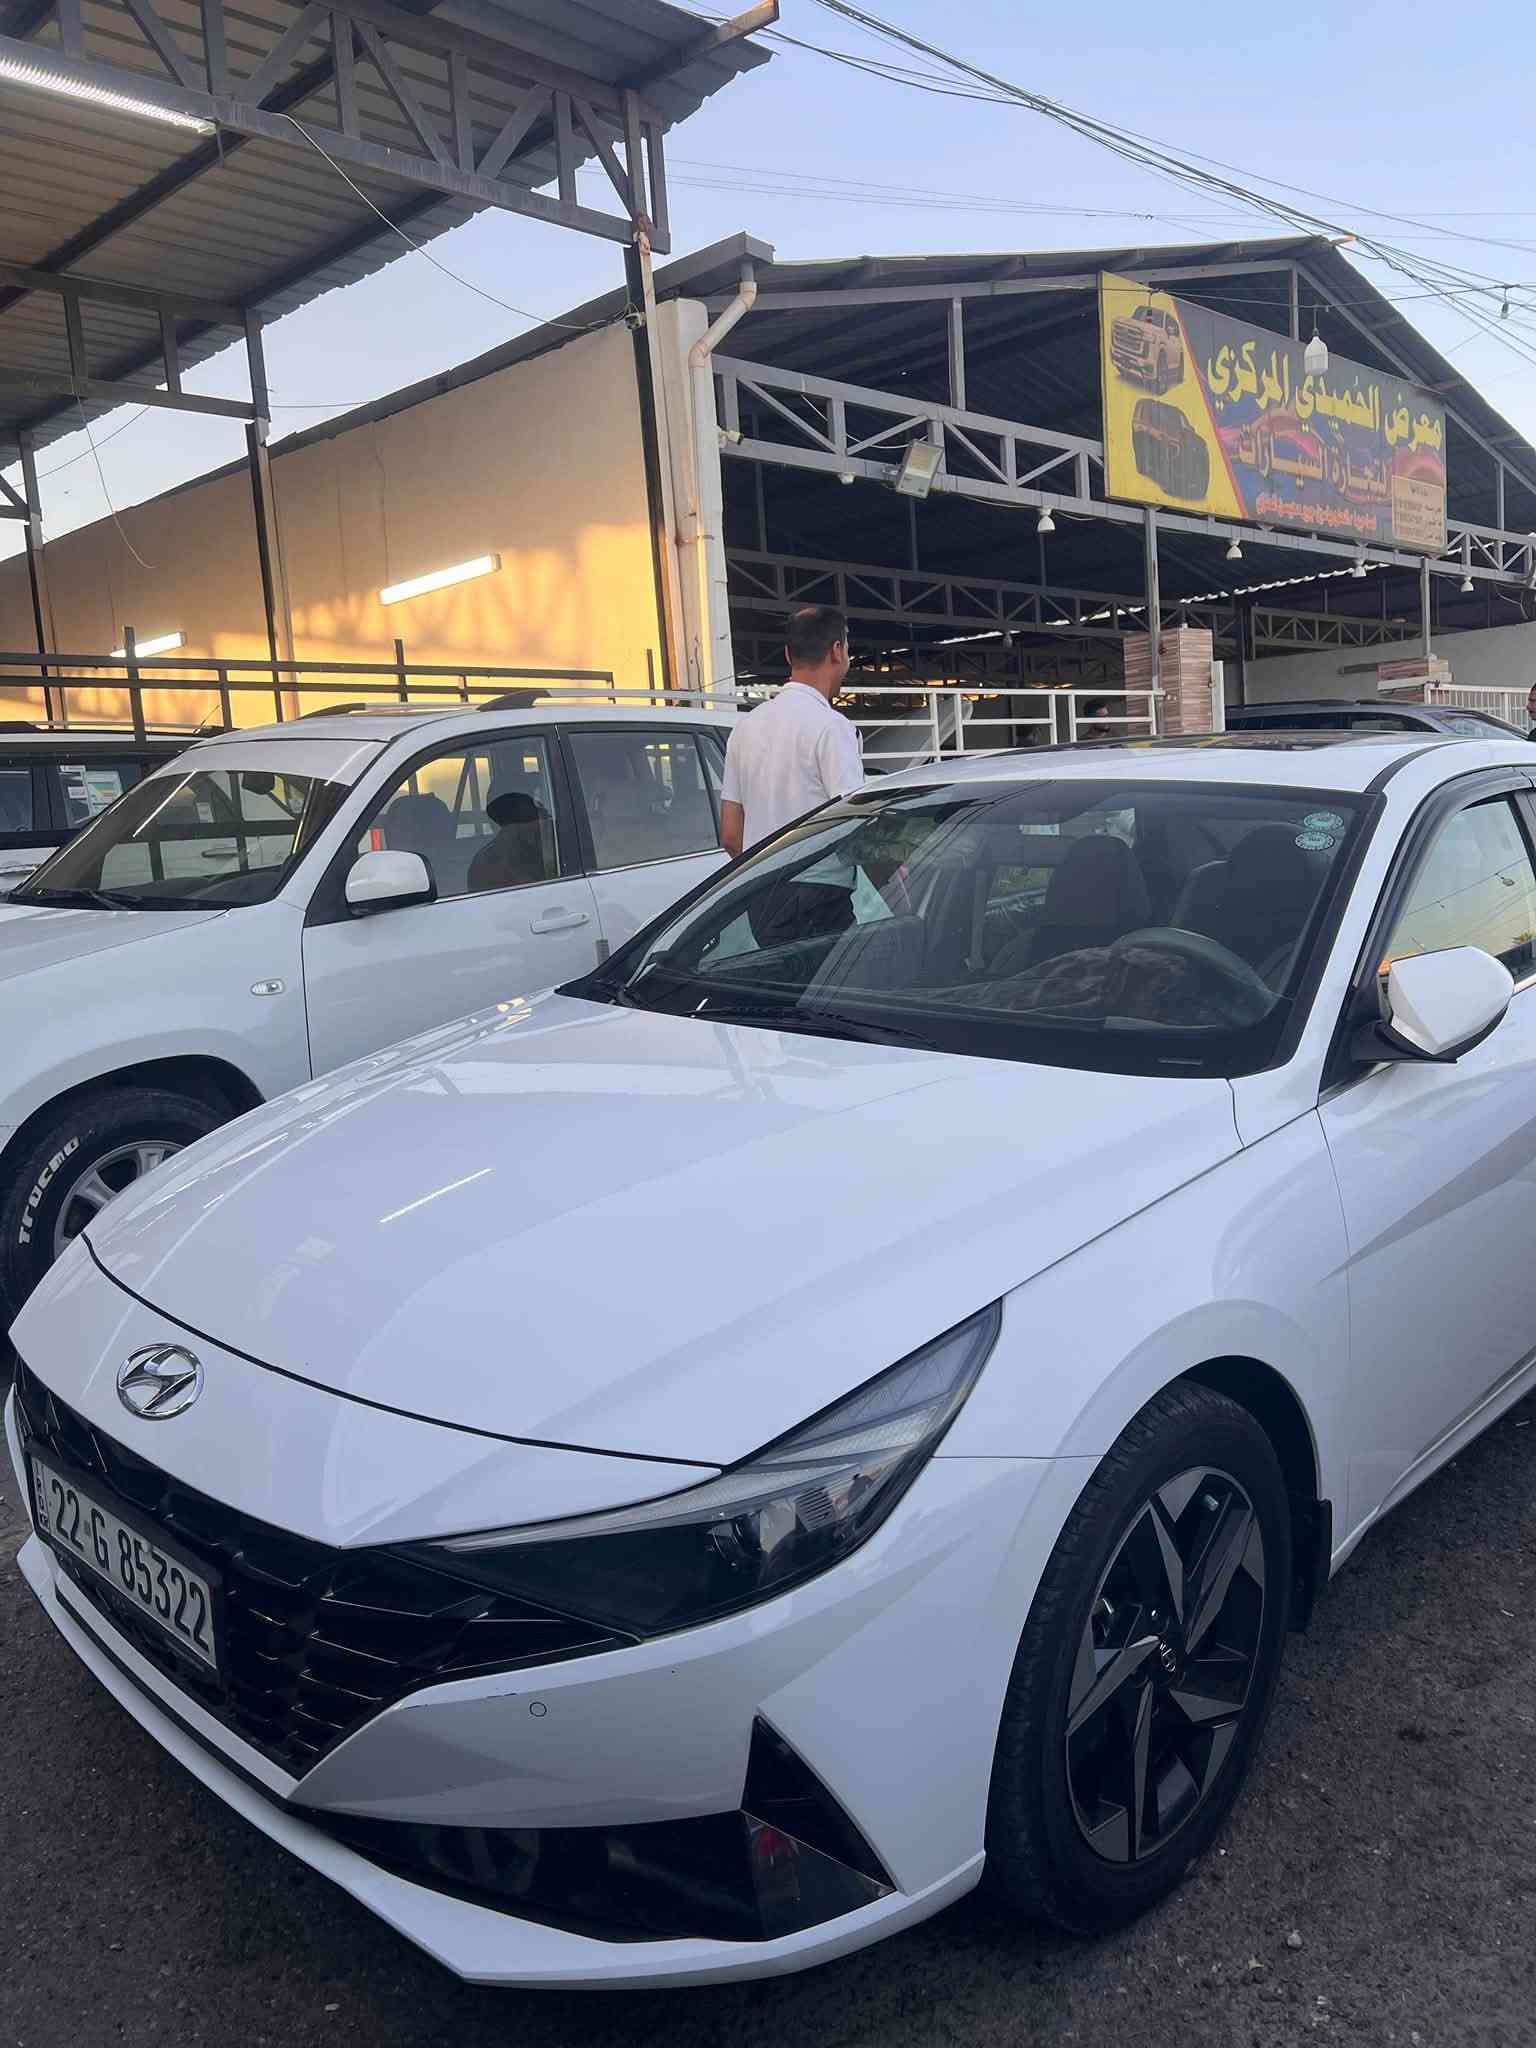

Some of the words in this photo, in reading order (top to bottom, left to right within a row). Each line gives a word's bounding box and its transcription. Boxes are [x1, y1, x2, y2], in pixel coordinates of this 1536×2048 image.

[1207, 340, 1290, 412] المركزي
[1385, 393, 1442, 452] معرض
[52, 1478, 84, 1552] 22
[90, 1508, 110, 1572] G
[118, 1528, 210, 1653] 85322
